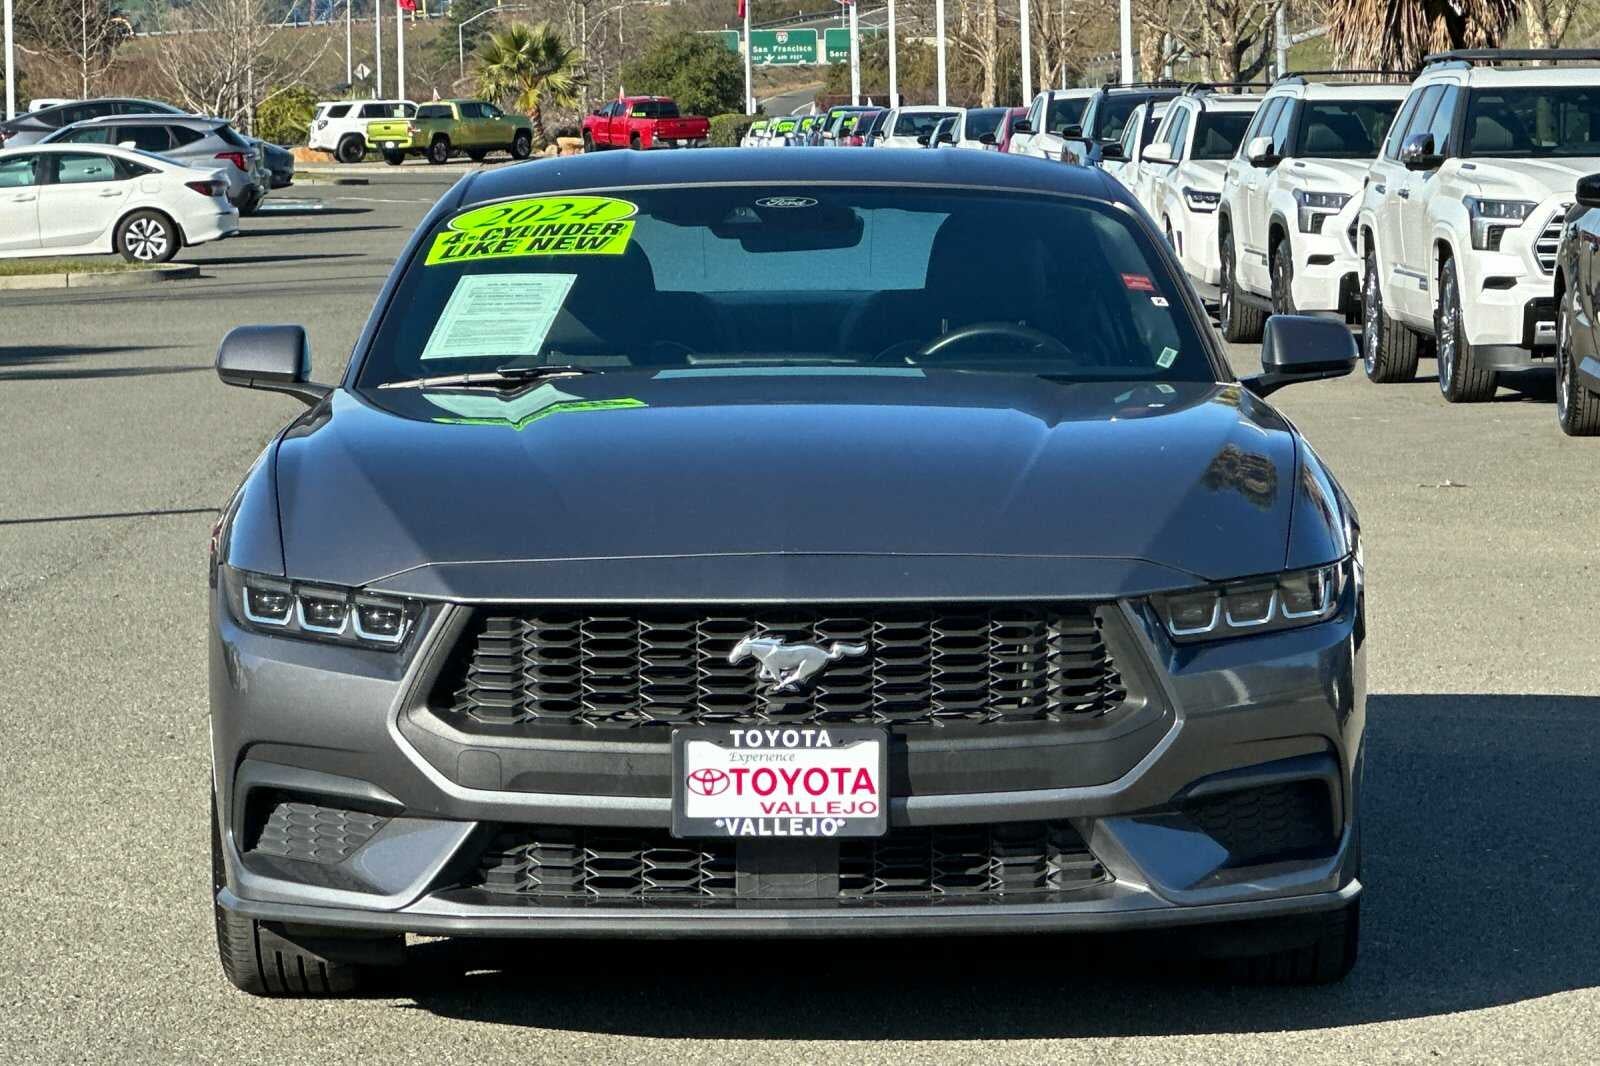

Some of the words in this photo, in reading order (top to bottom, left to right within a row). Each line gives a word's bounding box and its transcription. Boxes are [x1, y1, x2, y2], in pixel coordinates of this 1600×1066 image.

[772, 45, 812, 53] Francisco
[474, 201, 612, 229] 2024
[441, 221, 627, 246] 4-CYLINDER
[438, 239, 518, 260] LIKE
[524, 235, 611, 252] NEW
[729, 729, 832, 748] TOYOTA
[728, 751, 796, 765] Experience
[729, 767, 877, 797] TOYOTA
[760, 801, 877, 815] VALLEJO
[724, 818, 838, 836] VALLEJO
